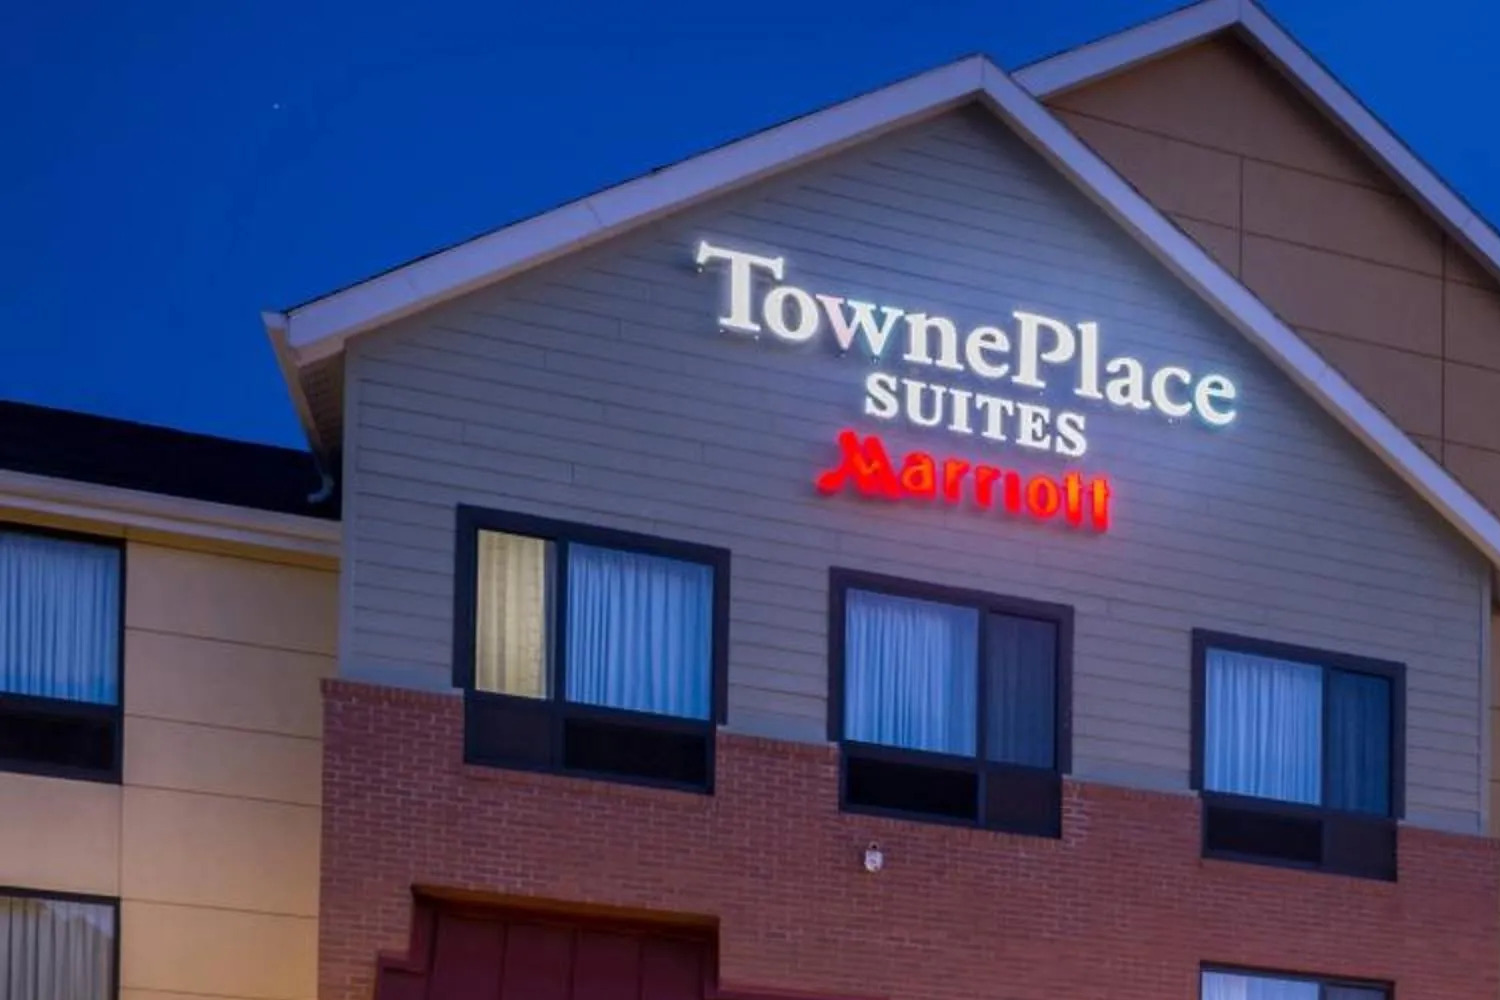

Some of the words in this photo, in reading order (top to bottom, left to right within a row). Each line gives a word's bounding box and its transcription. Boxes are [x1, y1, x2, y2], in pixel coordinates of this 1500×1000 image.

[695, 240, 1239, 426] TownePlace
[863, 371, 1089, 458] SUITES
[815, 429, 1112, 531] Marriott
